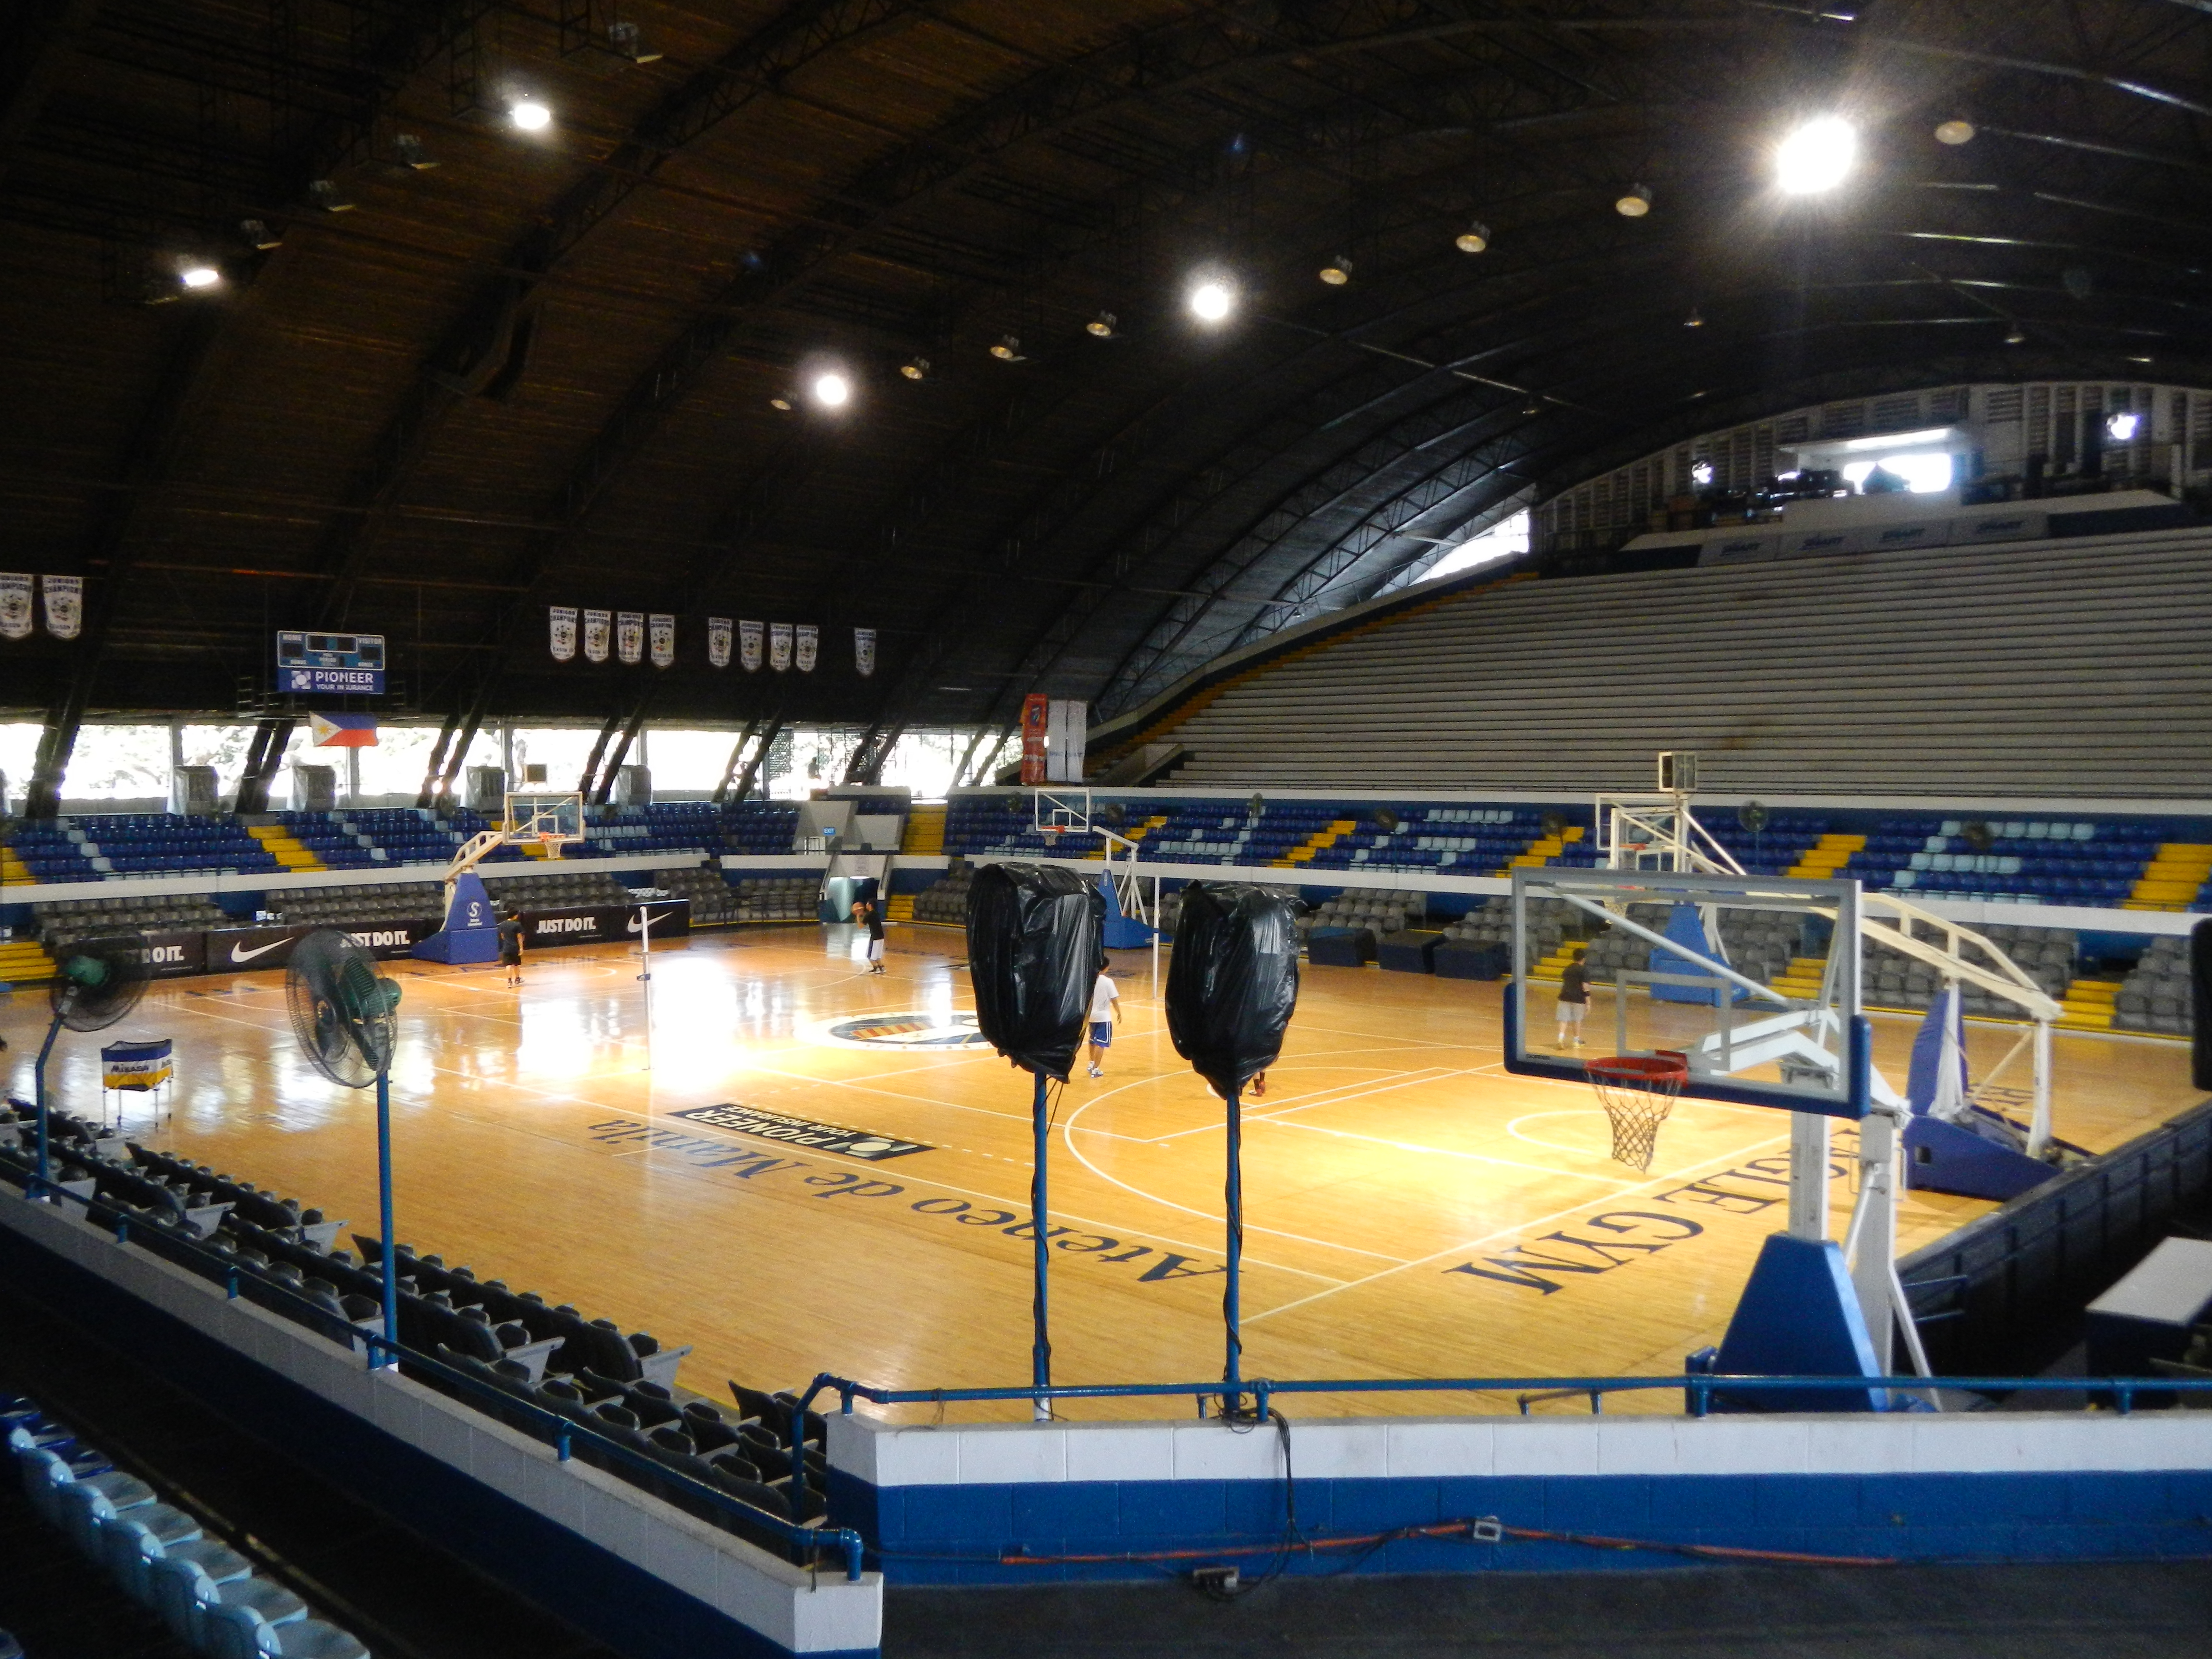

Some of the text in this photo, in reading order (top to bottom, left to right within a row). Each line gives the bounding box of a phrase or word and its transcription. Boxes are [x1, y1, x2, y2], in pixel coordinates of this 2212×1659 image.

[315, 671, 374, 684] PIONEER
[373, 931, 394, 947] DO
[536, 919, 564, 934] JUST
[565, 917, 583, 932] DO
[685, 1109, 837, 1146] PIONEER
[720, 1105, 857, 1138] YOUR INSURANCE
[588, 1119, 1244, 1283] Ateneo de Manila
[1440, 1211, 1704, 1296] GYM
